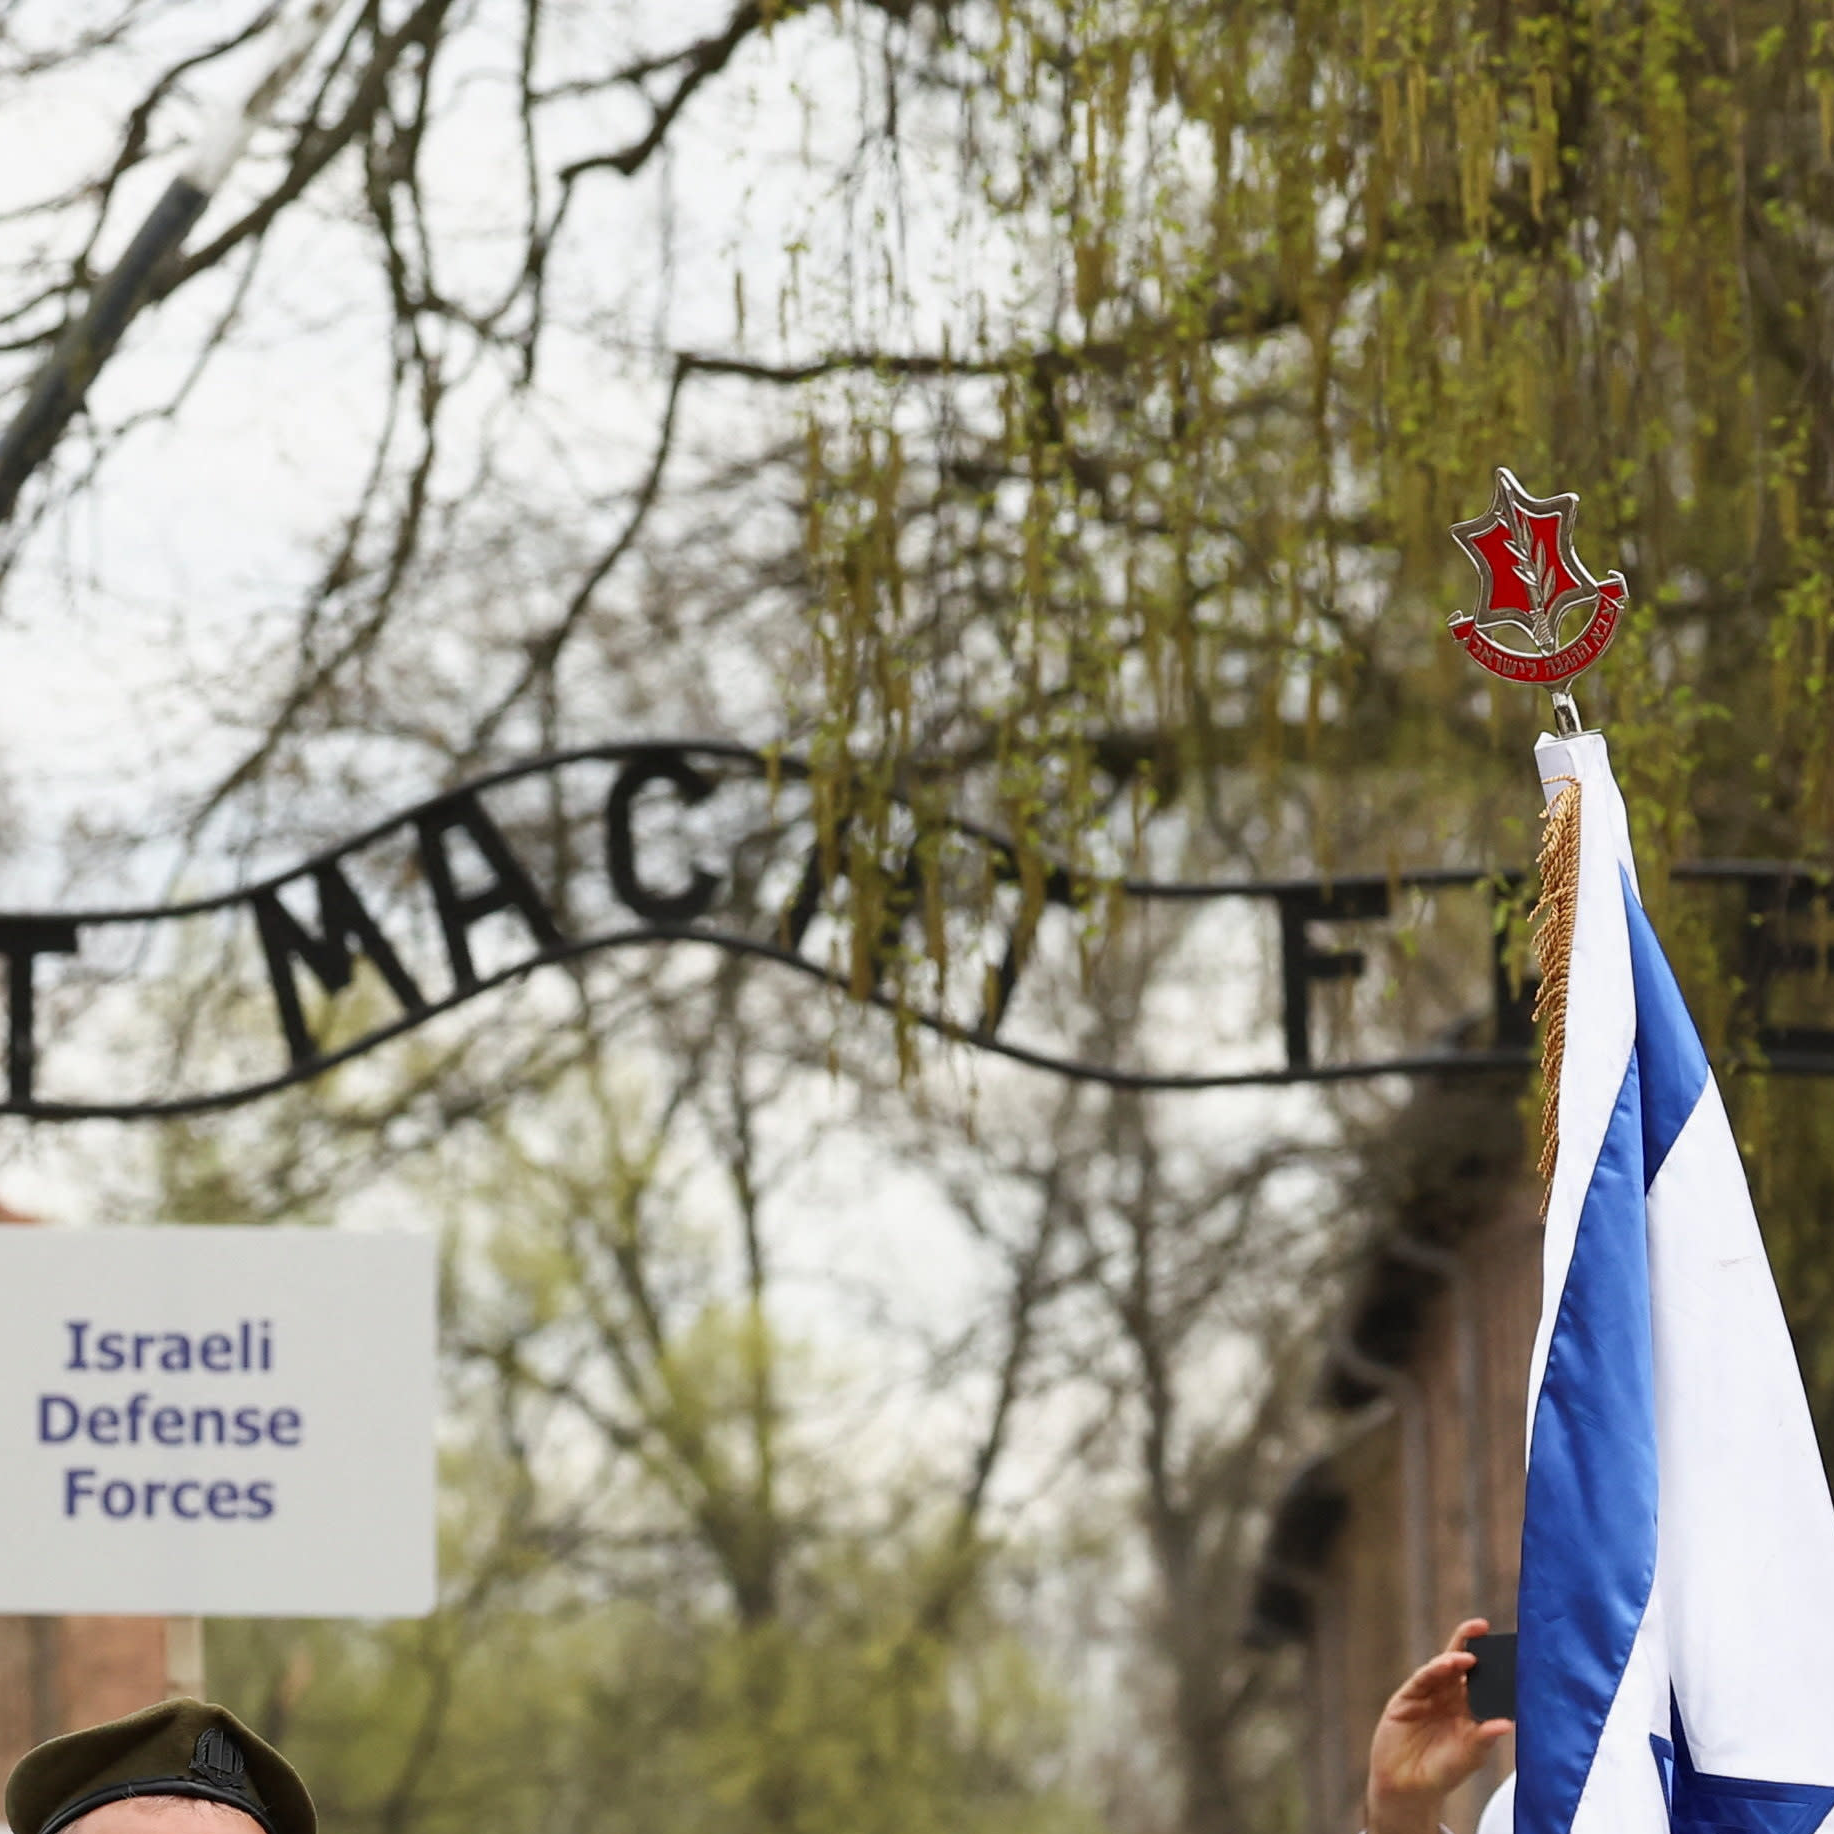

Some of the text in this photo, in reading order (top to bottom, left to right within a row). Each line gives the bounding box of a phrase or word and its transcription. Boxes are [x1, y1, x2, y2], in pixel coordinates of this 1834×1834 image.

[1591, 602, 1615, 647] צבא
[1545, 641, 1592, 678] ההגנה
[64, 1319, 273, 1373] Israeli
[37, 1394, 303, 1447] Defense
[63, 1467, 277, 1521] Forces
